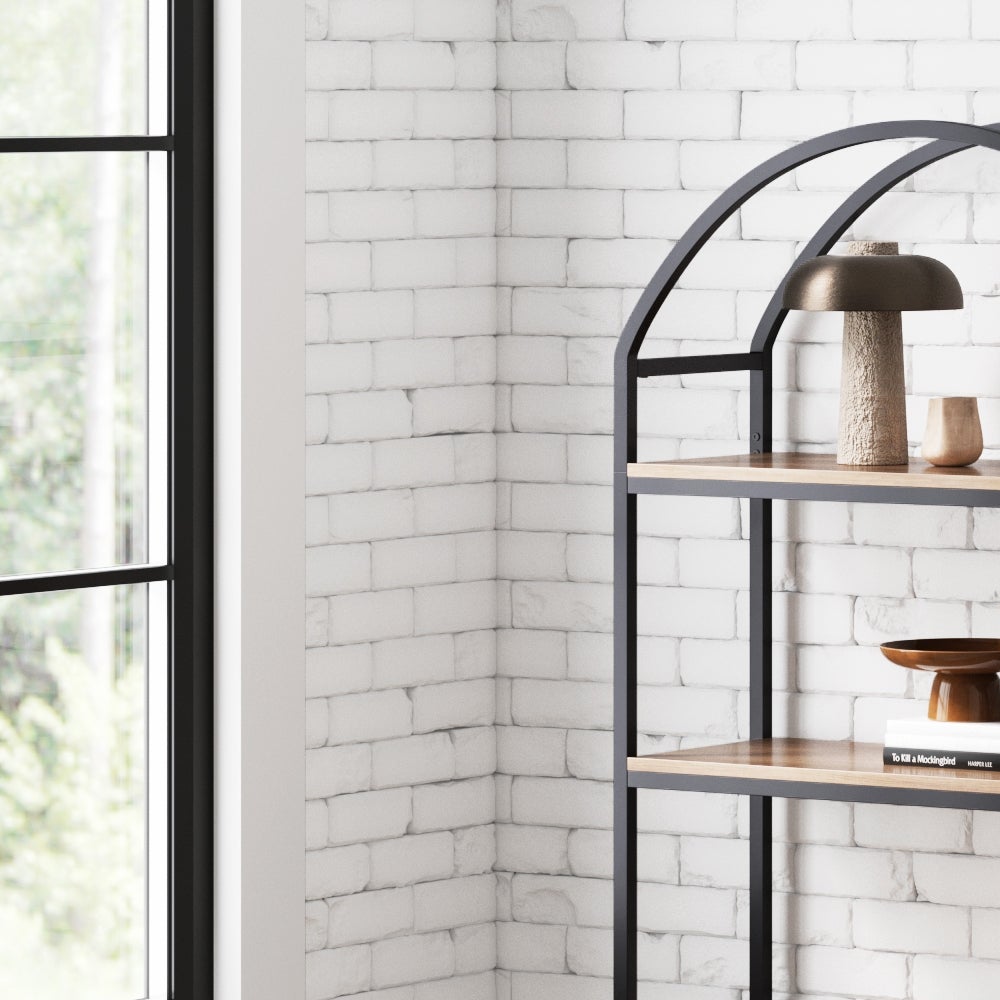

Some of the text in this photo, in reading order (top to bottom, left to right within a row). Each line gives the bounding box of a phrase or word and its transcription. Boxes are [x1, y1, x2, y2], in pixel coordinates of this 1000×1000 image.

[891, 753, 900, 762] To
[901, 754, 911, 763] Kill
[917, 755, 956, 766] Mockingbird
